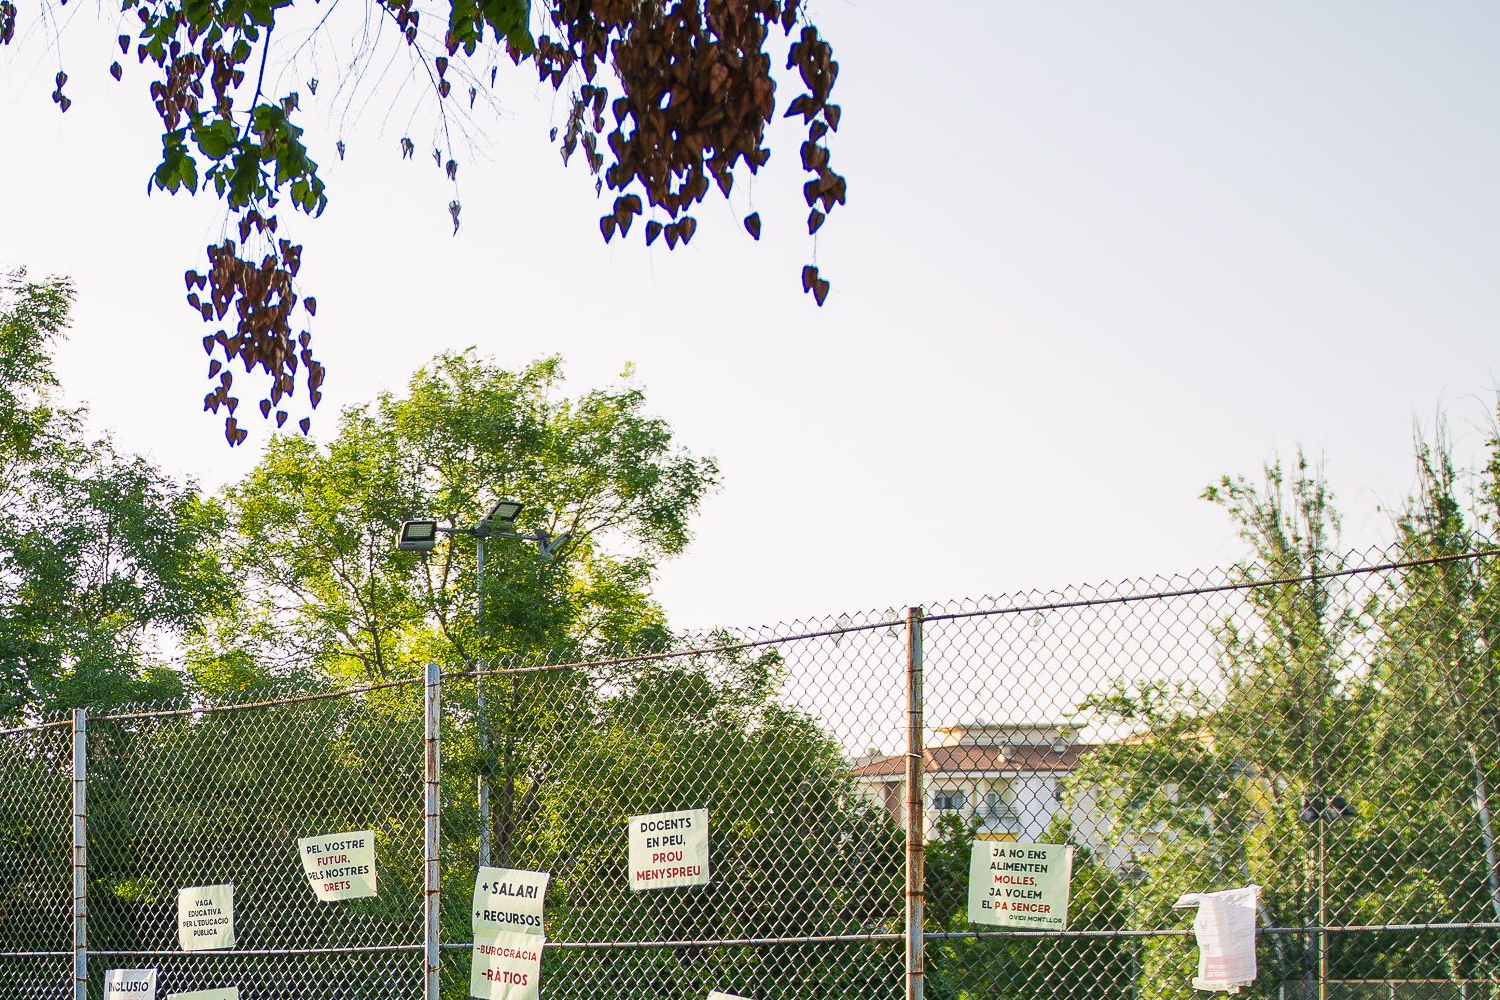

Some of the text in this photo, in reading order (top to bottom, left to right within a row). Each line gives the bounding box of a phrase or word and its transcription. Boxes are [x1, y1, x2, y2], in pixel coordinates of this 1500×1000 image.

[641, 818, 691, 832] DOCENTS
[306, 839, 364, 854] PEL VOSTRE
[647, 835, 686, 848] EN PEU,
[653, 851, 682, 863] PROU
[993, 849, 1046, 859] JA NO ENS
[308, 866, 369, 880] PELS NOSTRES
[637, 865, 700, 881] MENYSPREU
[990, 862, 1048, 873] ALIMENTEN
[324, 881, 350, 891] DRETS
[995, 875, 1037, 887] MOLLES,
[482, 882, 538, 899] + SALARI
[989, 888, 1042, 899] JA VOLEM
[189, 908, 221, 917] EDUCATIVA
[982, 901, 1050, 913] EL PA SENCER
[194, 916, 228, 926] L'EDUCACIÓ
[484, 910, 541, 927] RECURSOS
[194, 928, 217, 936] PÚBLICA
[109, 979, 148, 992] INCLUSIÓ
